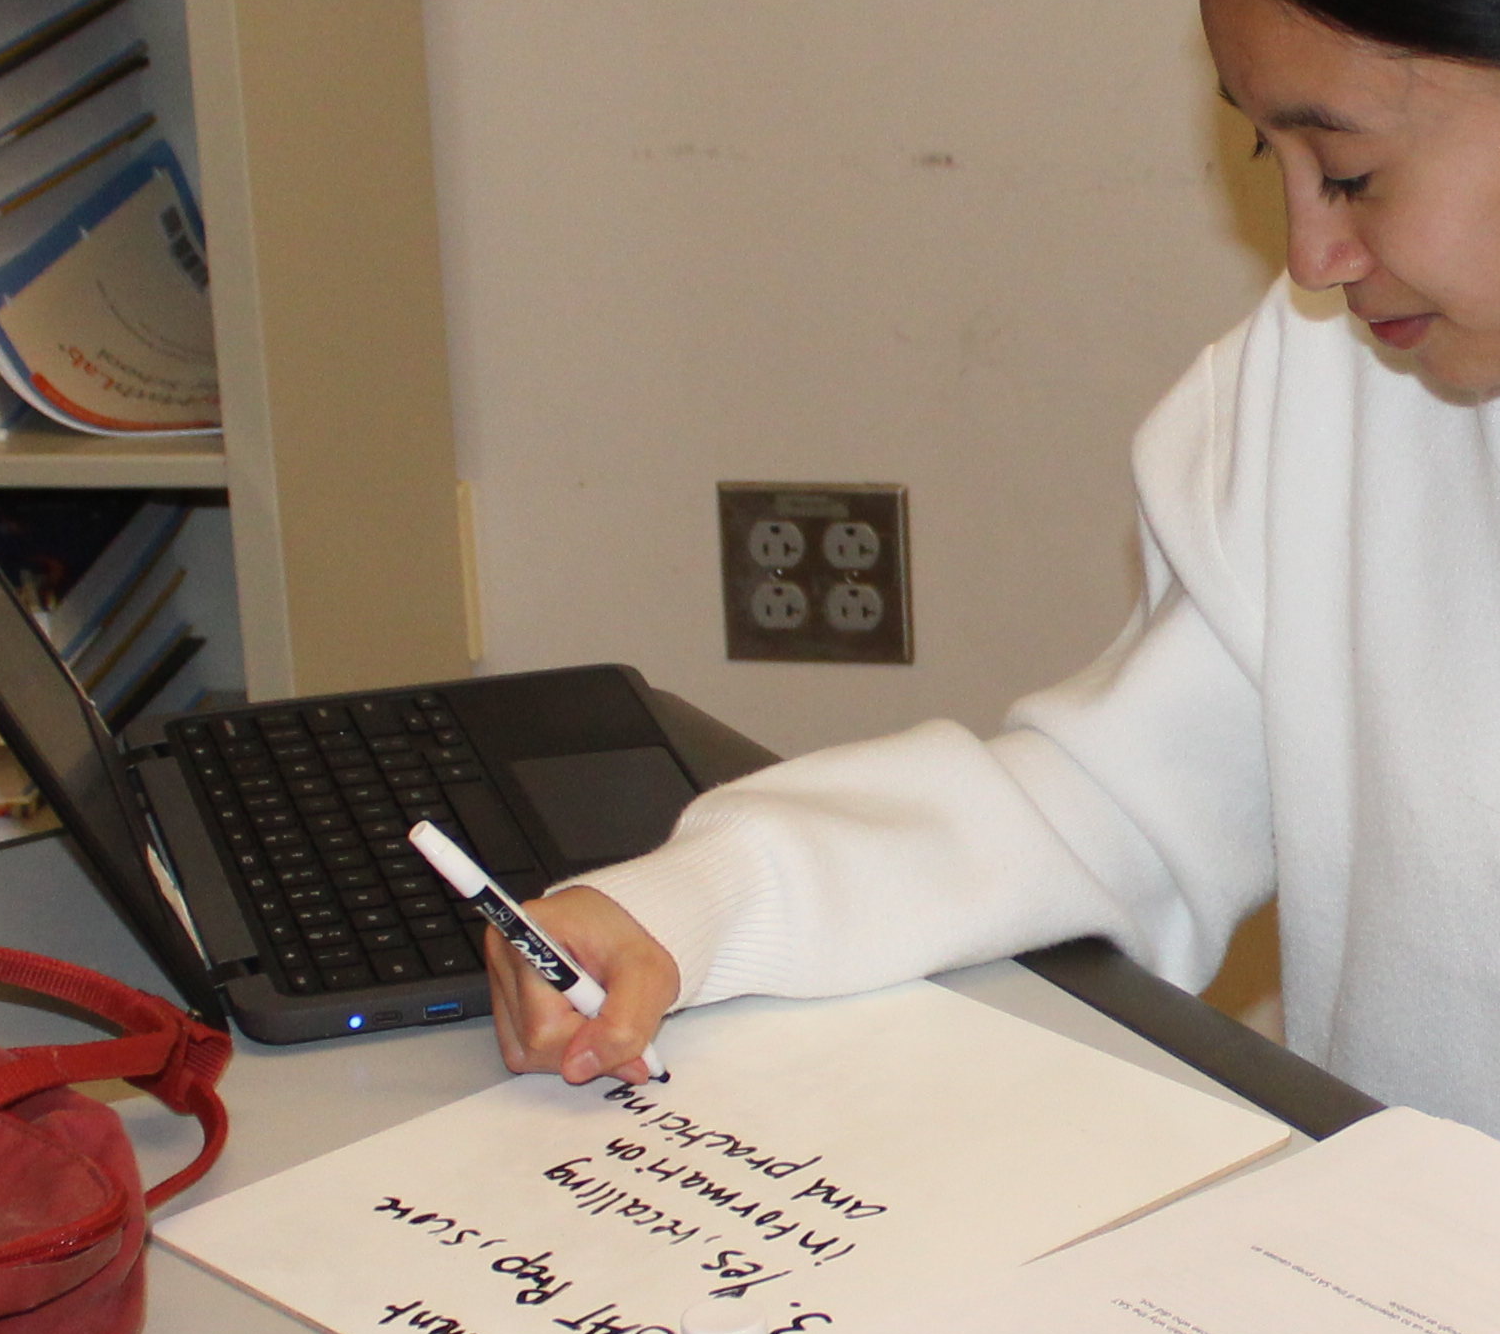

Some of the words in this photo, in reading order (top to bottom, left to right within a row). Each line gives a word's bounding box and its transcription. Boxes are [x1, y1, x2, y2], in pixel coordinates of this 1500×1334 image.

[522, 928, 542, 947] erase
[536, 943, 554, 962] dry
[601, 1079, 822, 1181] practicing
[543, 1156, 700, 1244] recalling
[791, 1157, 888, 1219] and
[374, 1196, 480, 1246] score
